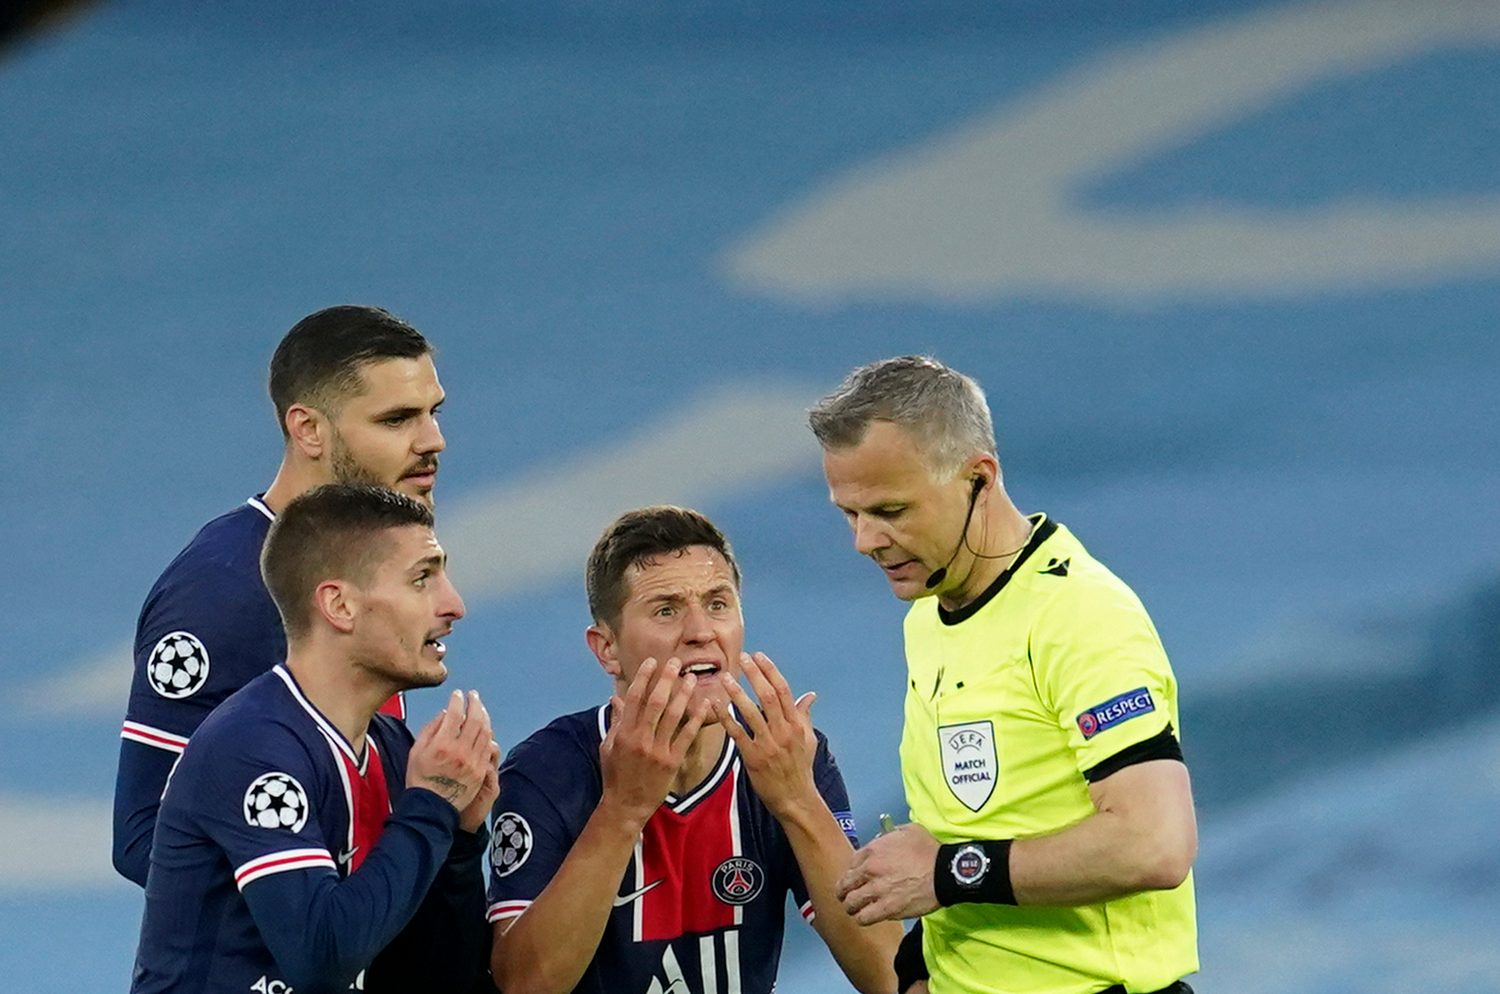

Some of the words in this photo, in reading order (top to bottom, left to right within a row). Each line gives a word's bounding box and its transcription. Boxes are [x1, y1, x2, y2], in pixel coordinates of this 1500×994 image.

[1096, 693, 1151, 724] RESPECT
[950, 734, 983, 750] UEFA
[954, 759, 986, 771] MATCH
[951, 772, 992, 785] OFFICIAL
[720, 860, 754, 873] PARIS
